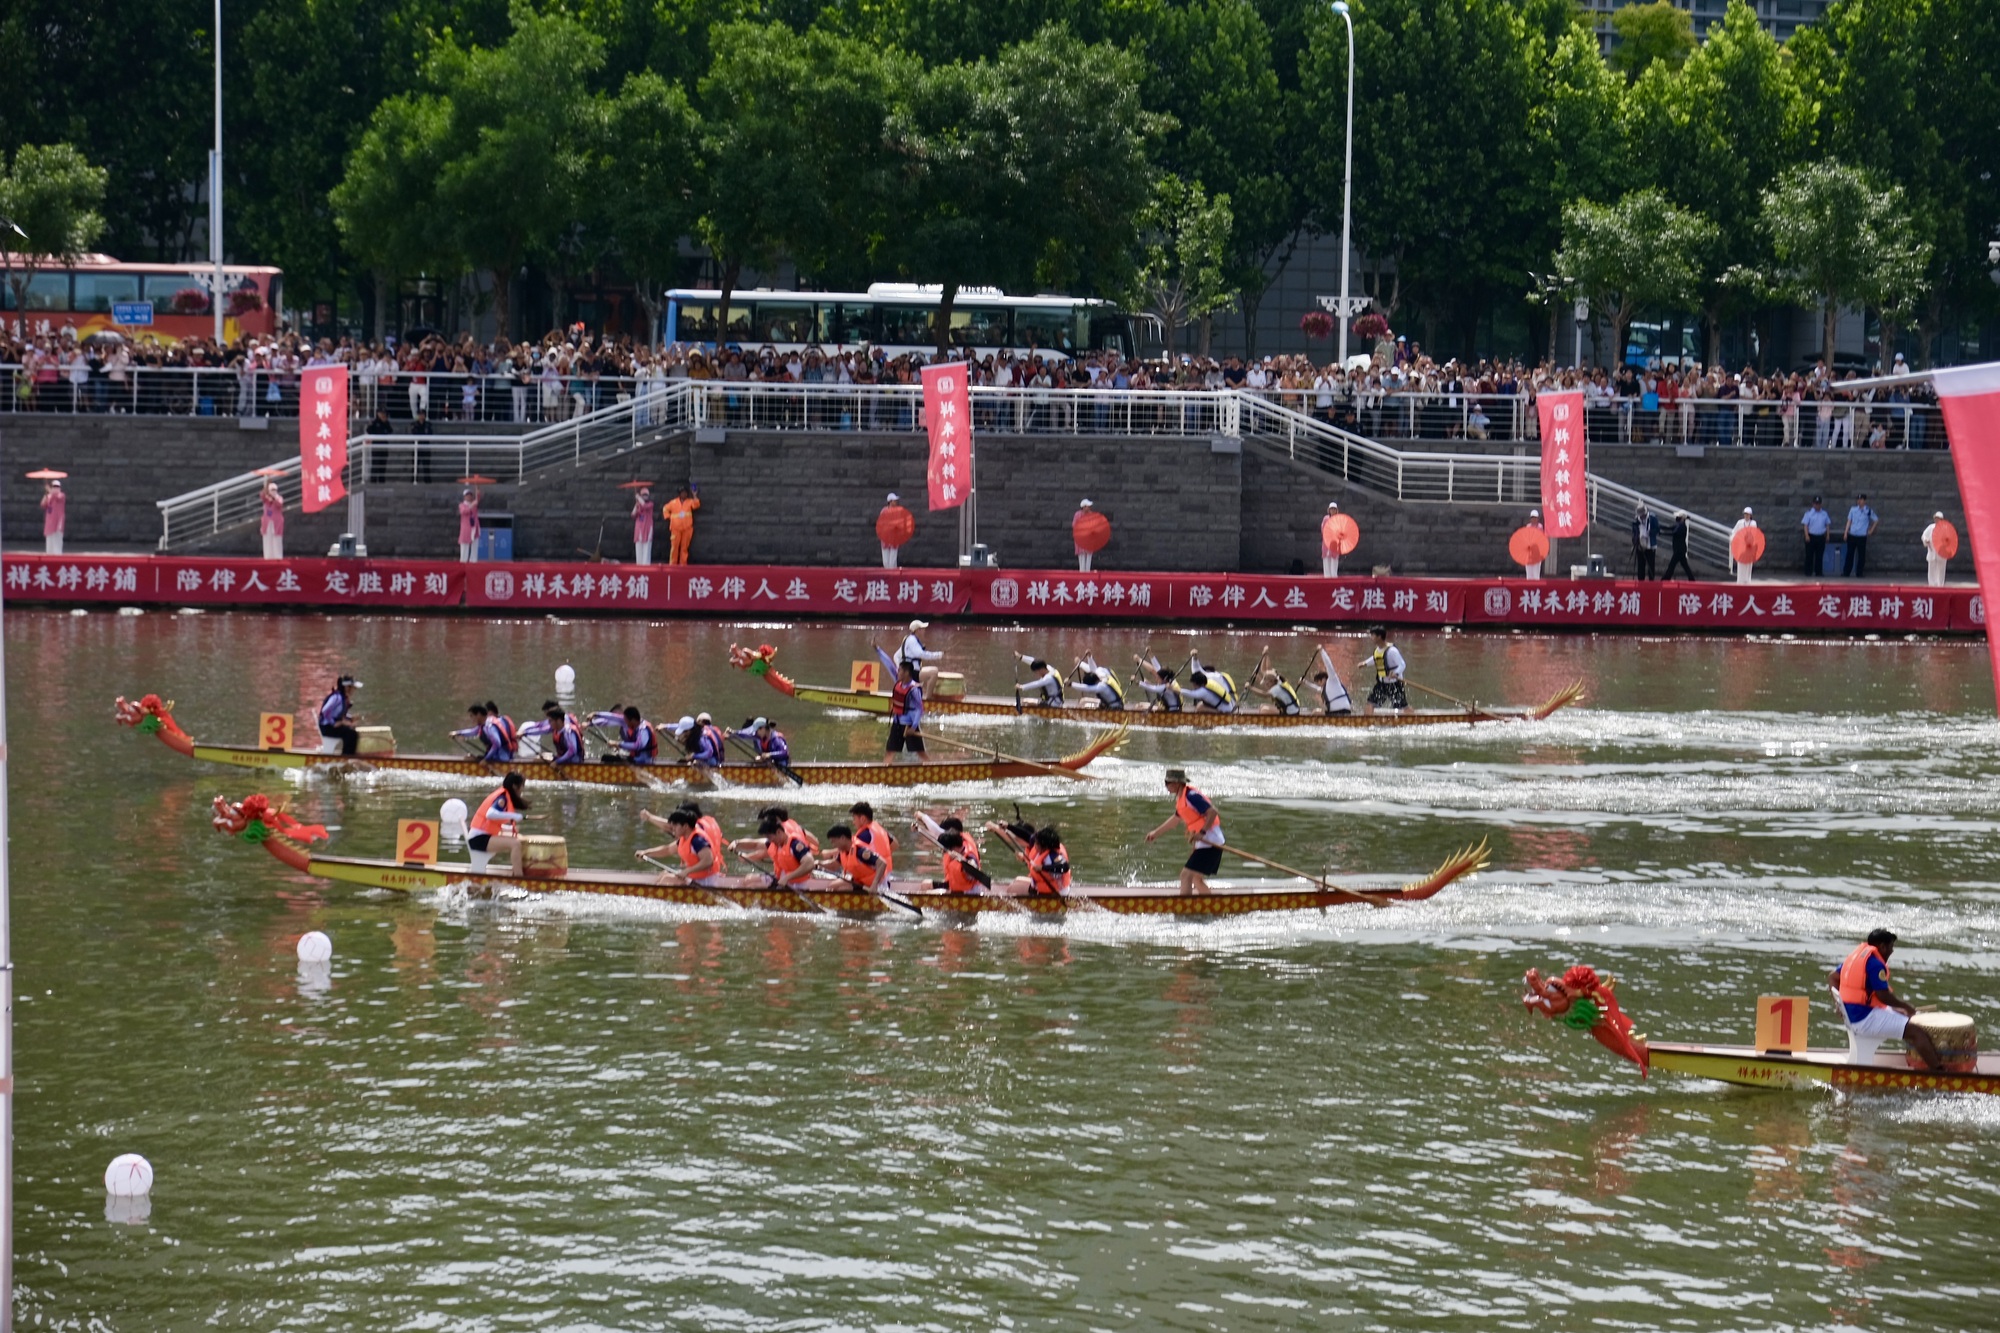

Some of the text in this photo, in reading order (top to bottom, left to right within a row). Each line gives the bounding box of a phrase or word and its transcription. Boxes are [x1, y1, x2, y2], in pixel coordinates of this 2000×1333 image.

[177, 568, 301, 593] 陪伴人生
[324, 569, 448, 595] 定胜时刻
[688, 577, 810, 601] 陪伴人生
[834, 578, 954, 604] 定胜时刻
[1189, 584, 1308, 609] 陪伴人生
[1330, 587, 1448, 614] 定胜时刻
[1679, 593, 1795, 617] 陪伴人生
[1817, 594, 1934, 620] 定胜时刻
[855, 663, 875, 688] 4
[265, 715, 287, 745] 3
[403, 822, 431, 860] 2
[1770, 999, 1793, 1045] 1
